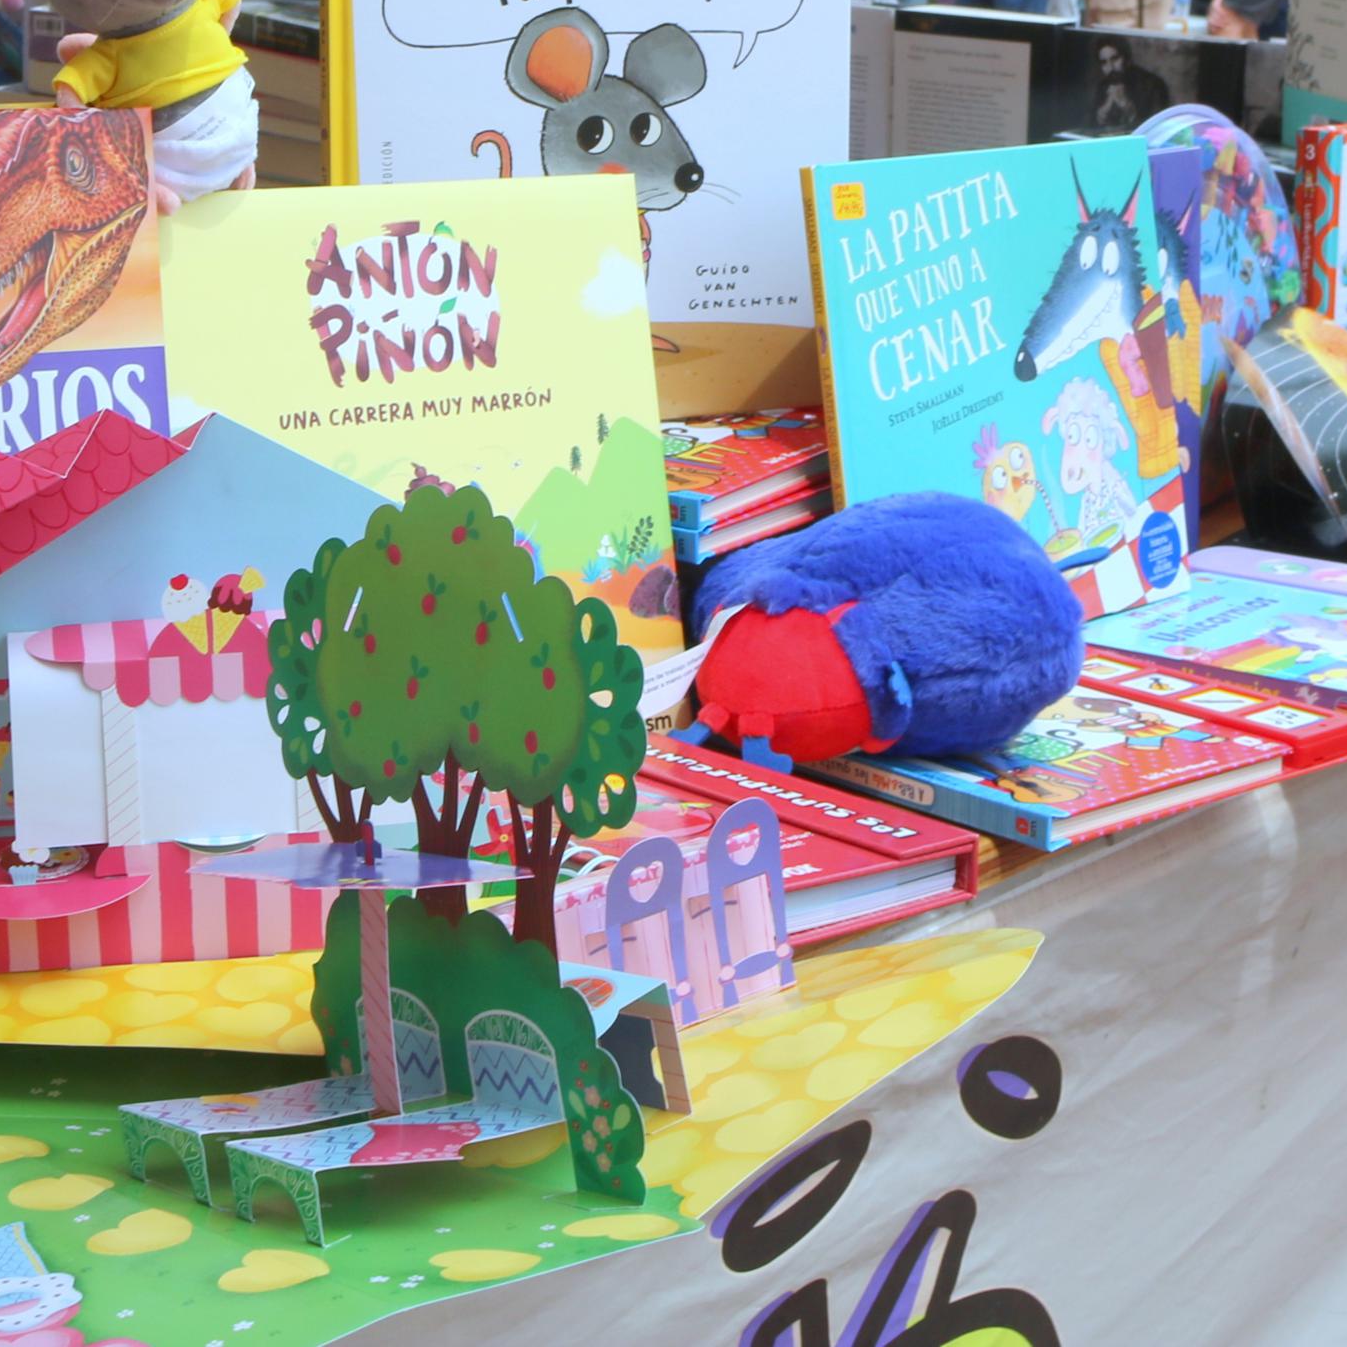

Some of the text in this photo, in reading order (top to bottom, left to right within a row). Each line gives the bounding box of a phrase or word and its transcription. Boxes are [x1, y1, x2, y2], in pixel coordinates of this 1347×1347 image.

[839, 227, 888, 284] LA
[888, 170, 1019, 266] PATITA
[688, 294, 800, 311] GENECHTEN
[704, 282, 738, 293] VAN
[855, 246, 988, 333] QUE VINO A
[867, 295, 1007, 402] CENAR
[279, 386, 552, 430] UNA CARRERA MUY MARRÓN
[888, 383, 964, 427] STEVE SMALLMAN
